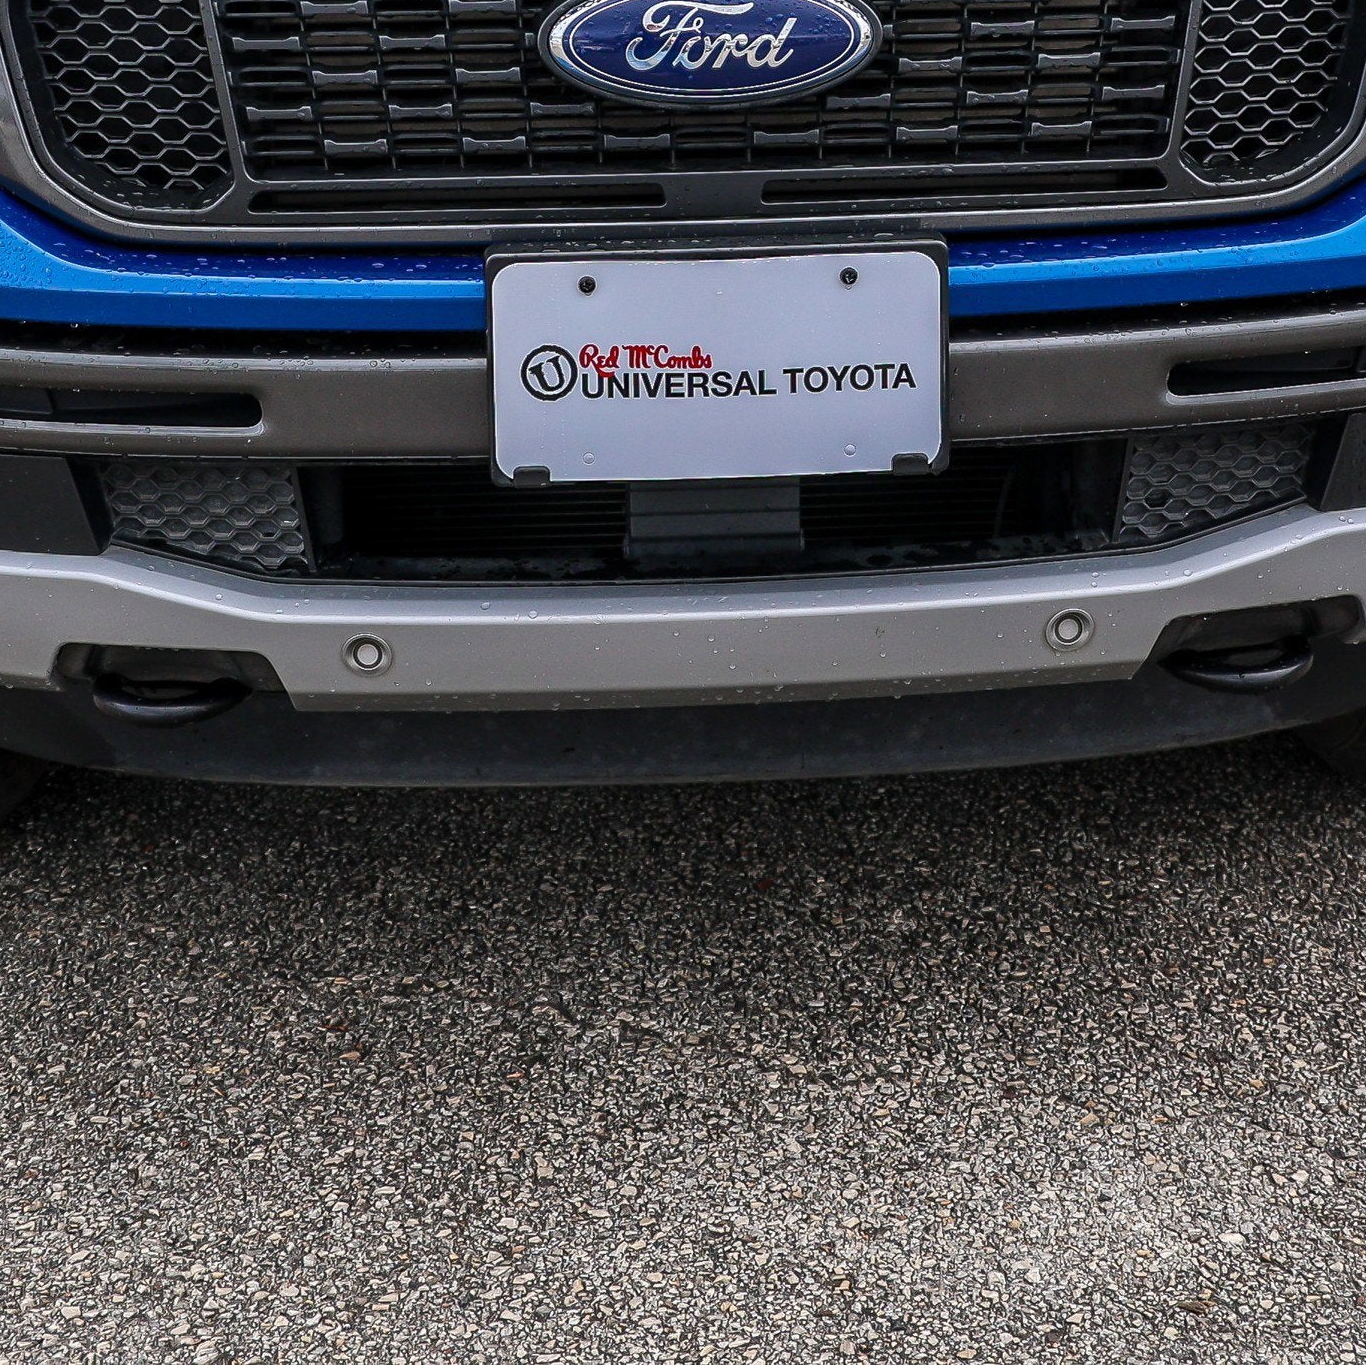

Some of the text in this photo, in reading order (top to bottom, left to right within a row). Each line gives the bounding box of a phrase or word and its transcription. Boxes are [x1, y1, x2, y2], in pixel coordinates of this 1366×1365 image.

[625, 0, 797, 71] Ford
[579, 343, 712, 378] Red McCombs
[581, 362, 917, 399] UNIVERSAL TOYOTA
